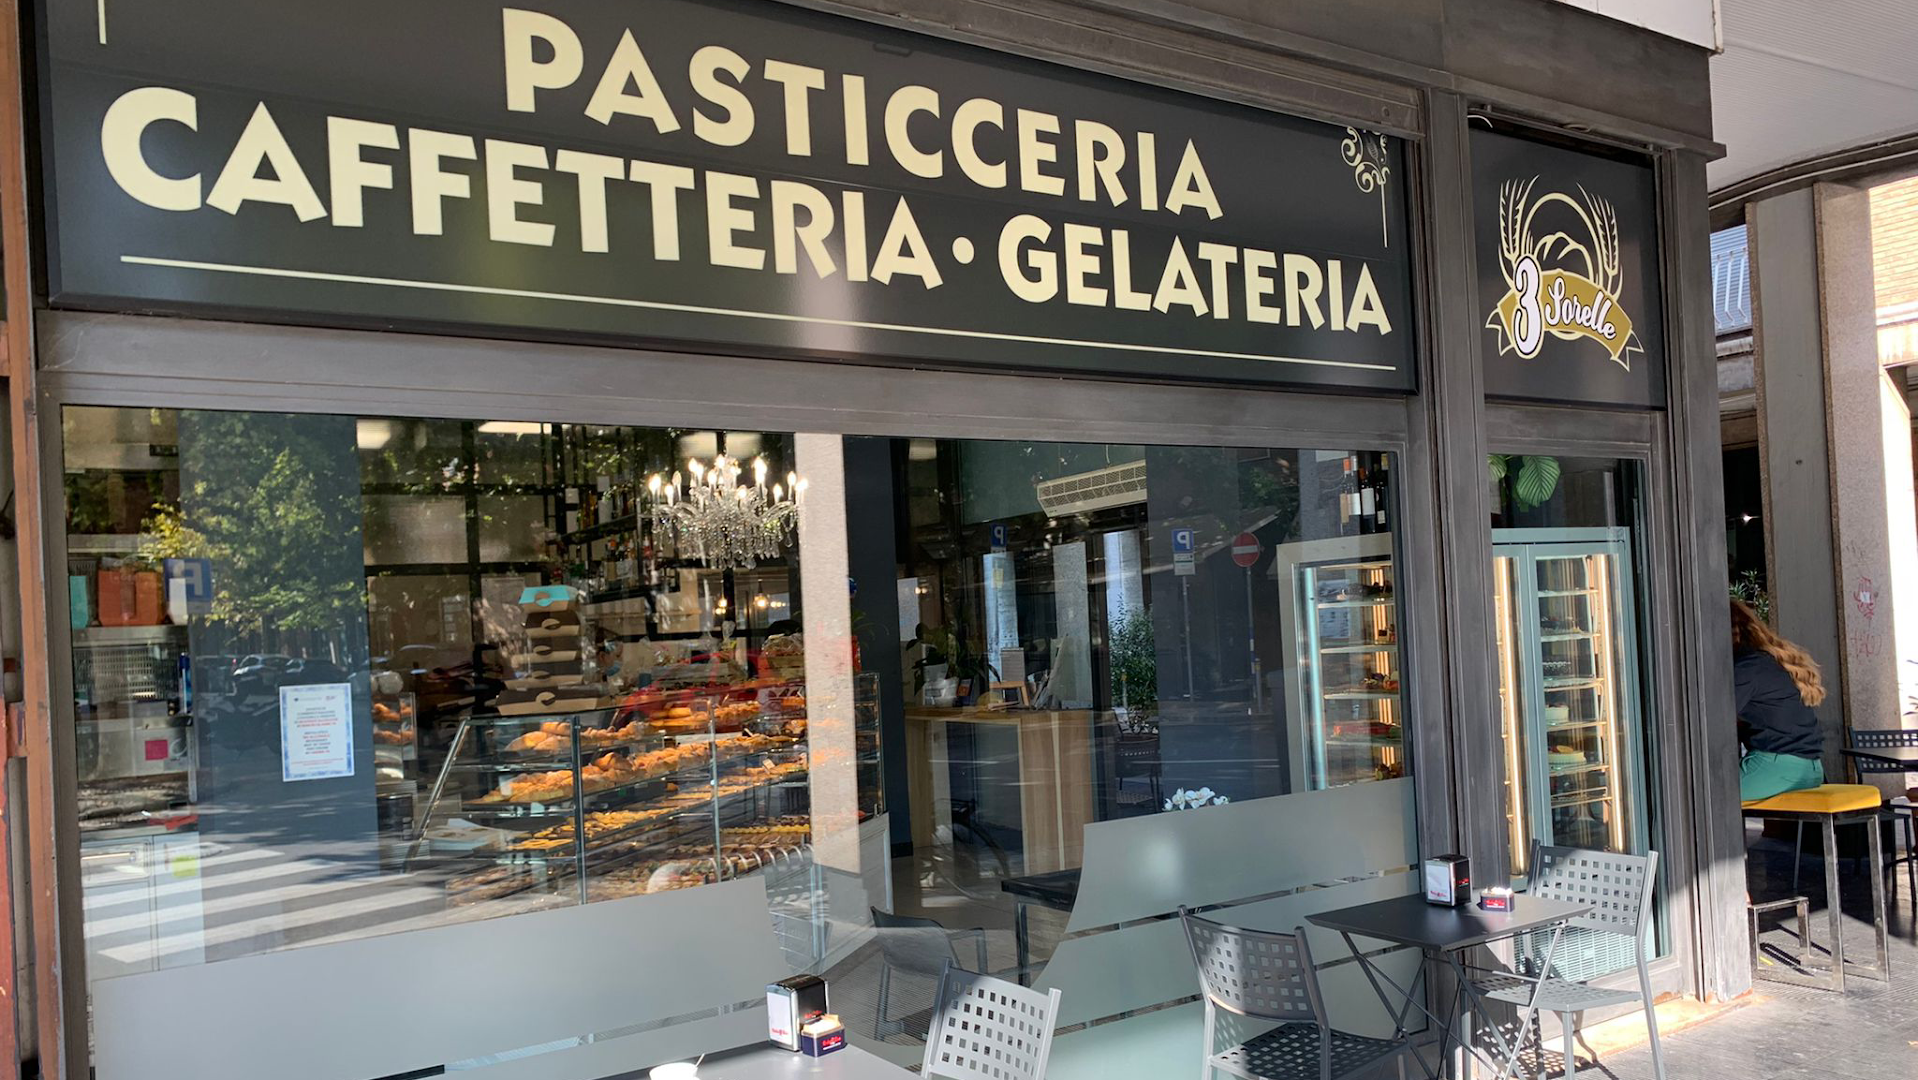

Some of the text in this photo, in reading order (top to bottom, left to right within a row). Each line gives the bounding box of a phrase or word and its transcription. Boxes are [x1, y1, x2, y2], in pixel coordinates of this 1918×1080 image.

[101, 87, 1392, 336] CAFFETTERIA GELATERIA
[503, 8, 1223, 220] PASTICCERIA
[1514, 256, 1616, 354] 3 Sorelle
